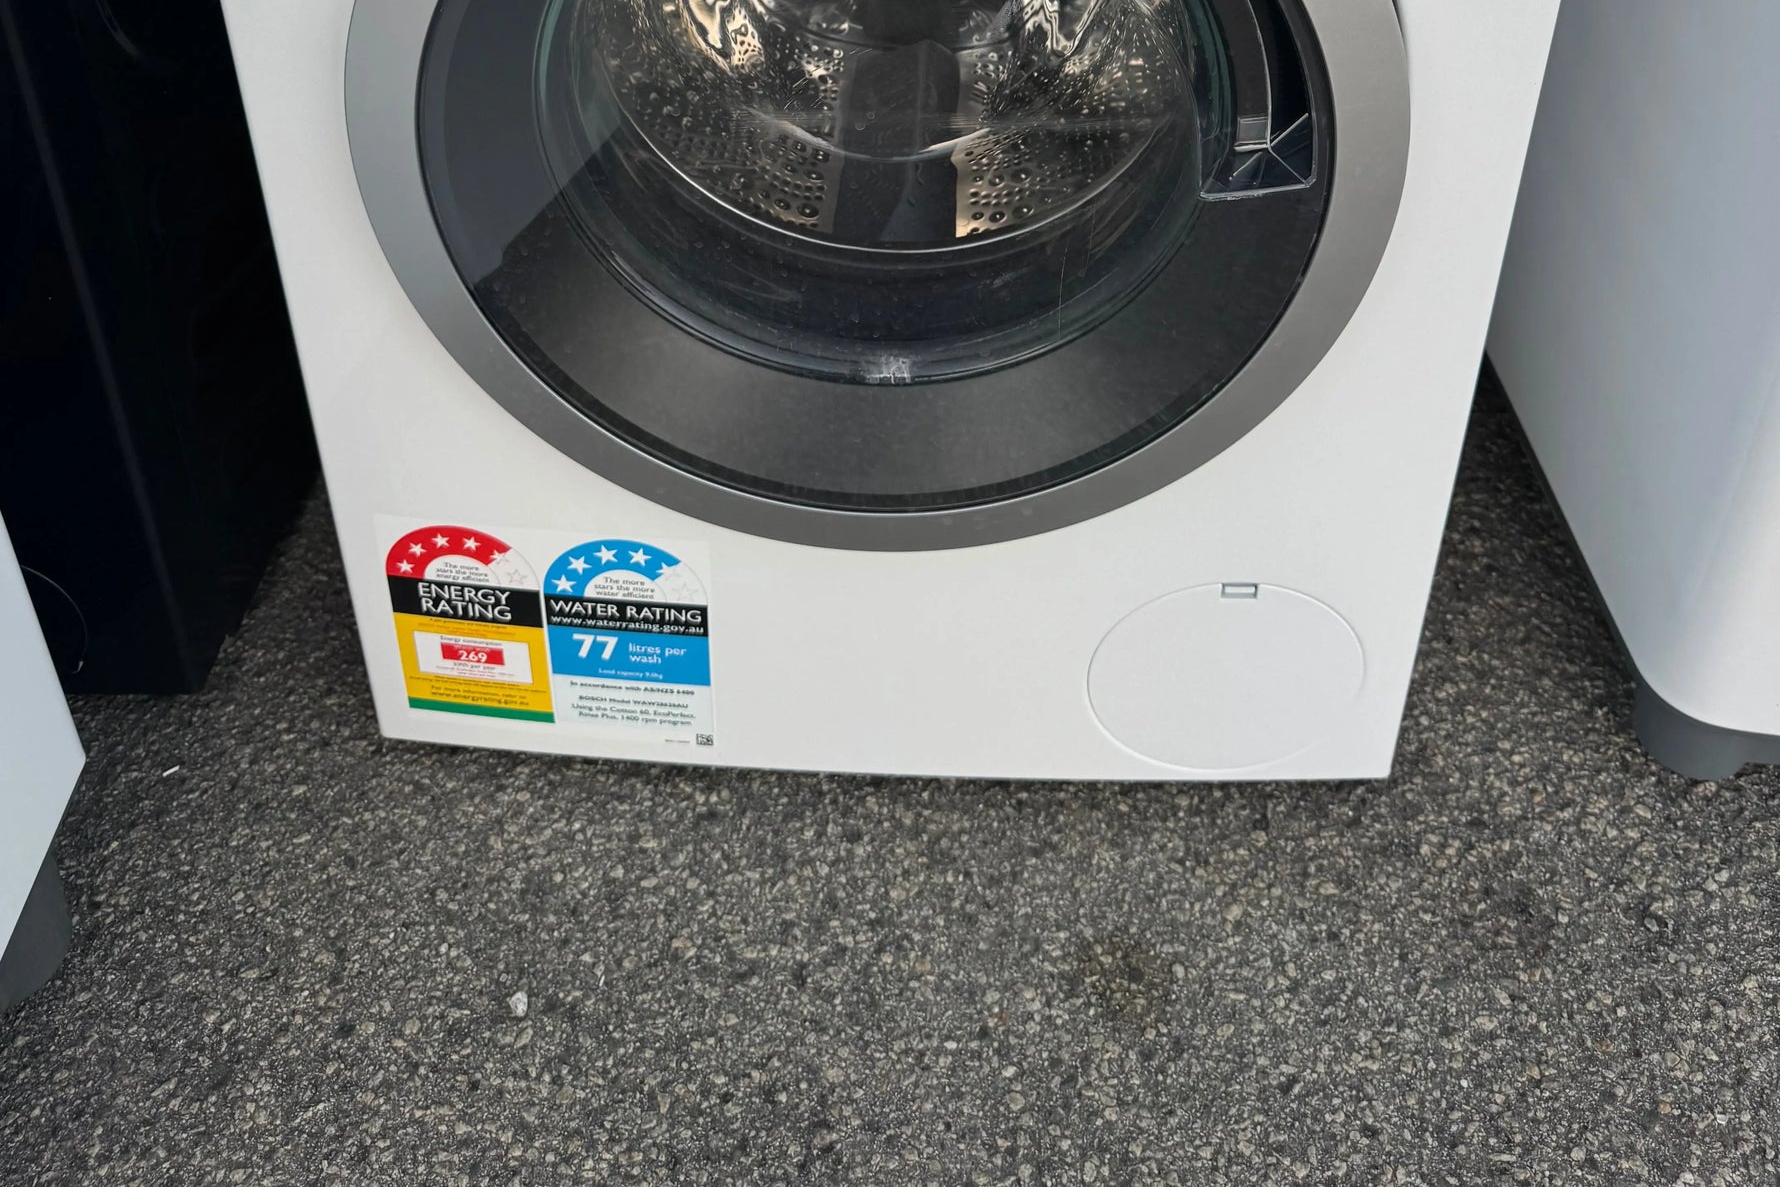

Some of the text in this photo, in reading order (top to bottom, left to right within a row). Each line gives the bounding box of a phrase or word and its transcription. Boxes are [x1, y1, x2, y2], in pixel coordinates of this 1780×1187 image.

[594, 583, 614, 591] stars
[616, 584, 631, 592] the
[603, 576, 645, 586] The more
[417, 581, 511, 605] ENERGY
[595, 590, 655, 600] water efficient
[421, 597, 512, 623] RATING
[550, 599, 702, 623] WATER RATING
[550, 615, 704, 635] www.waterrating.gov.au
[572, 633, 619, 661] 77
[628, 642, 687, 658] litres per
[459, 650, 488, 663] 269
[629, 654, 662, 664] wash
